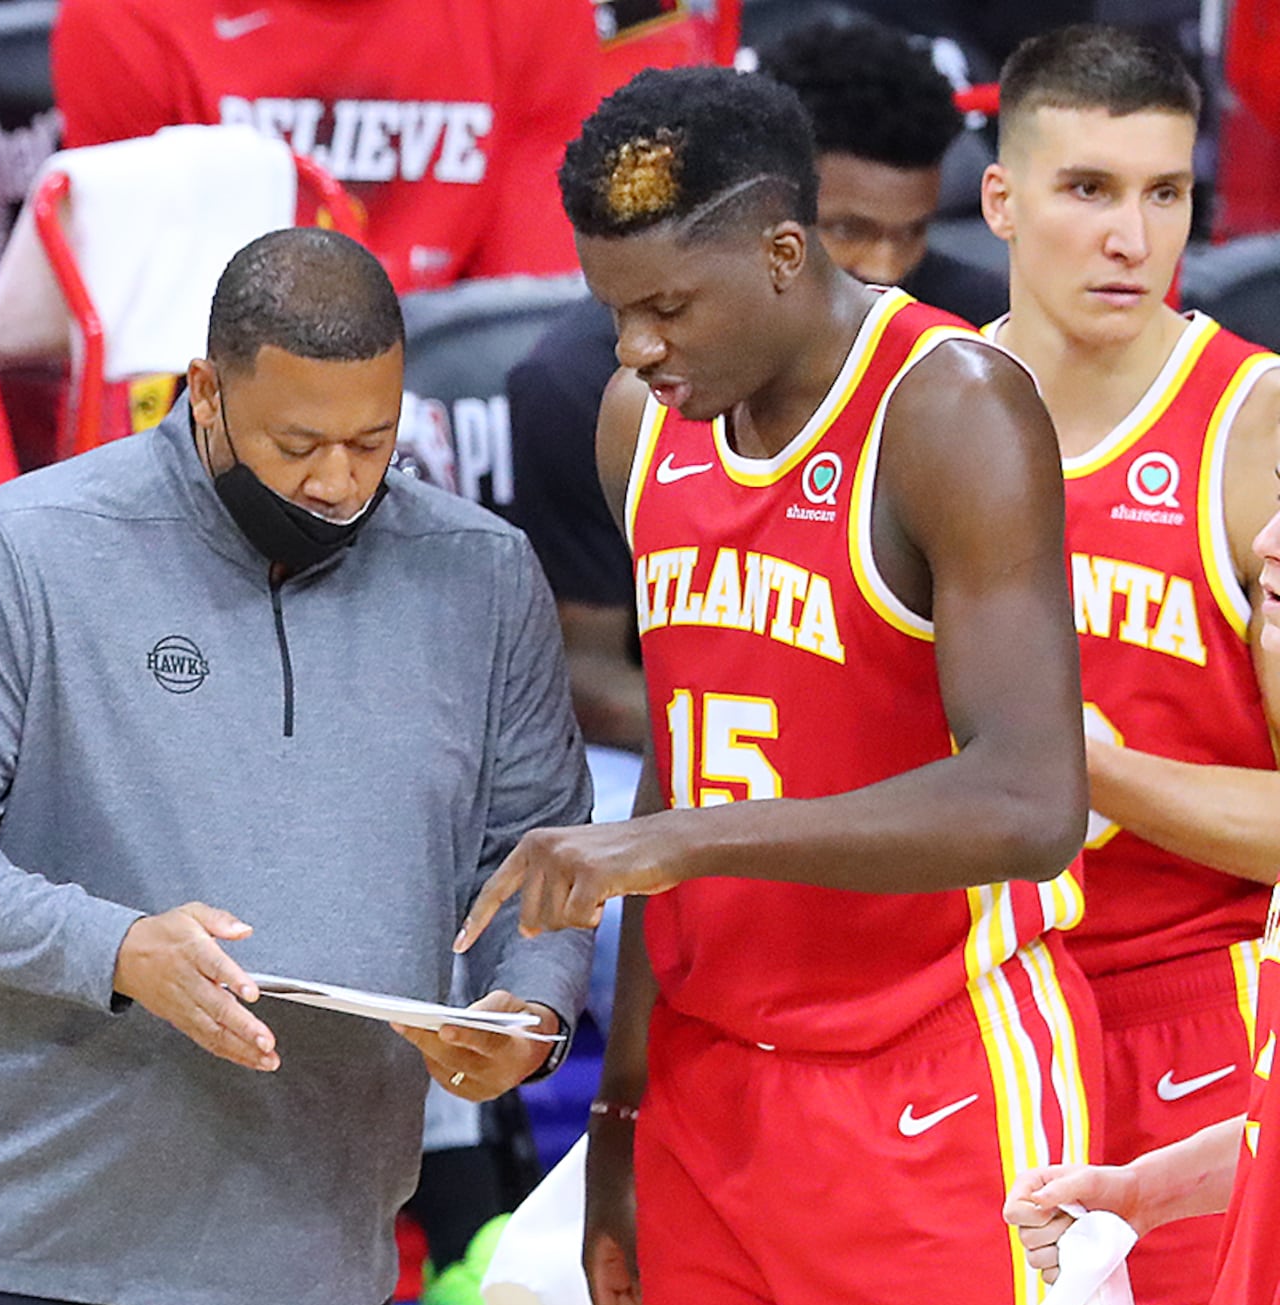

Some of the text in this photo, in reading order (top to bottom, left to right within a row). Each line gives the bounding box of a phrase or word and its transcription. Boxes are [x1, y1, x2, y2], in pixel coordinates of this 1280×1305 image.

[786, 503, 836, 522] sharecare
[1110, 503, 1185, 526] sharecare
[146, 651, 210, 676] HAWKS
[666, 688, 783, 810] 15
